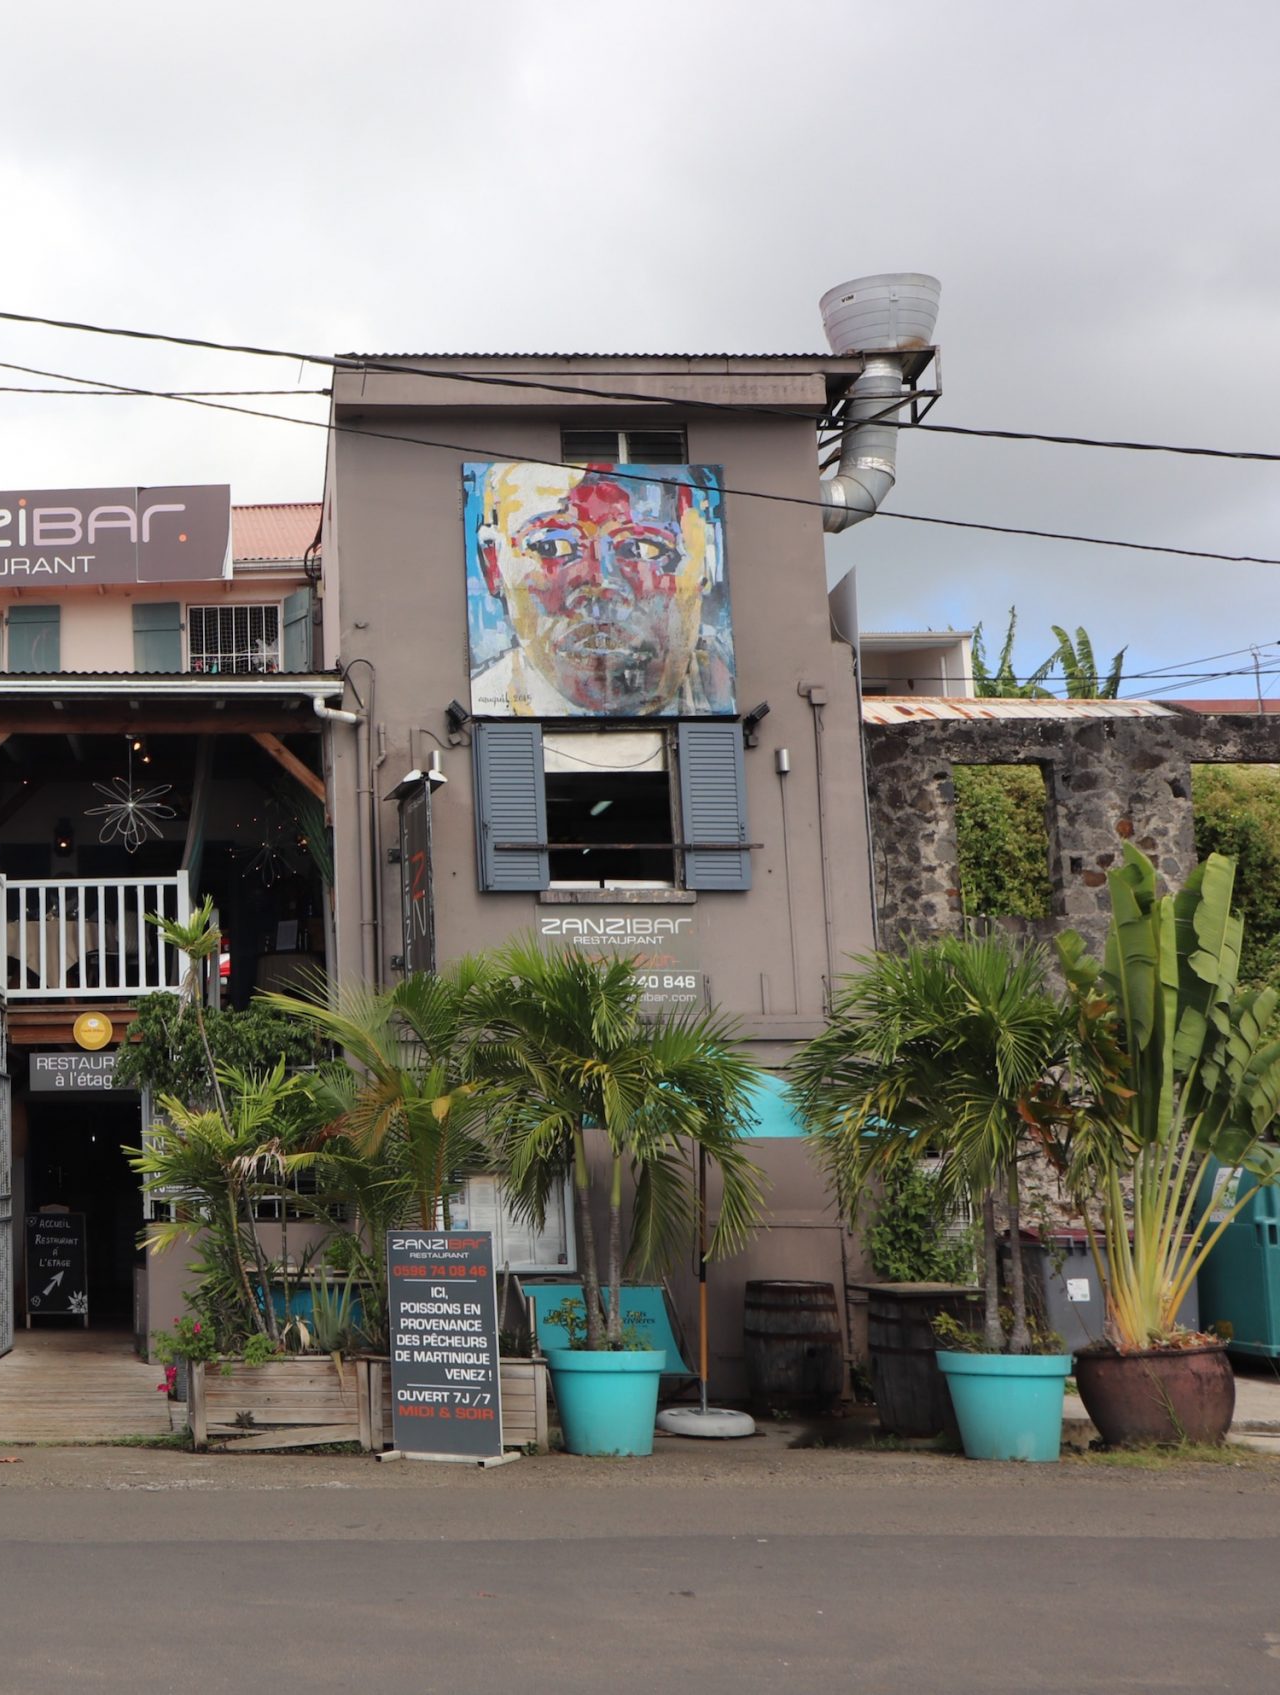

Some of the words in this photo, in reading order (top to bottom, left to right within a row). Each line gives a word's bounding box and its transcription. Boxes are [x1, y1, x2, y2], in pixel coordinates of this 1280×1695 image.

[573, 935, 664, 945] RESTAURANT
[663, 975, 696, 989] 846
[36, 1056, 115, 1070] RESTAUR
[55, 1072, 65, 1087] à
[69, 1071, 113, 1090] l'étag
[39, 1219, 71, 1228] ACCUEIL
[409, 1251, 470, 1259] RESTAURANT
[393, 1265, 427, 1277] 0596
[430, 1265, 446, 1277] 74
[448, 1265, 466, 1277] 08
[469, 1265, 487, 1277] 46
[430, 1286, 448, 1300] ICI,
[400, 1302, 461, 1315] POISSONS
[464, 1303, 481, 1315] EN
[400, 1318, 482, 1332] PROVENANCE
[396, 1333, 419, 1346] DES
[423, 1332, 487, 1348] PÊCHEURS
[395, 1350, 411, 1362] DE
[413, 1350, 490, 1365] MARTINIQUE
[445, 1368, 486, 1381] VENEZ
[488, 1370, 492, 1381] !
[397, 1389, 449, 1404] OUVERT
[453, 1392, 470, 1404] 7J
[399, 1404, 435, 1417] MIDI
[439, 1407, 451, 1419] &
[455, 1407, 494, 1420] SOIR
